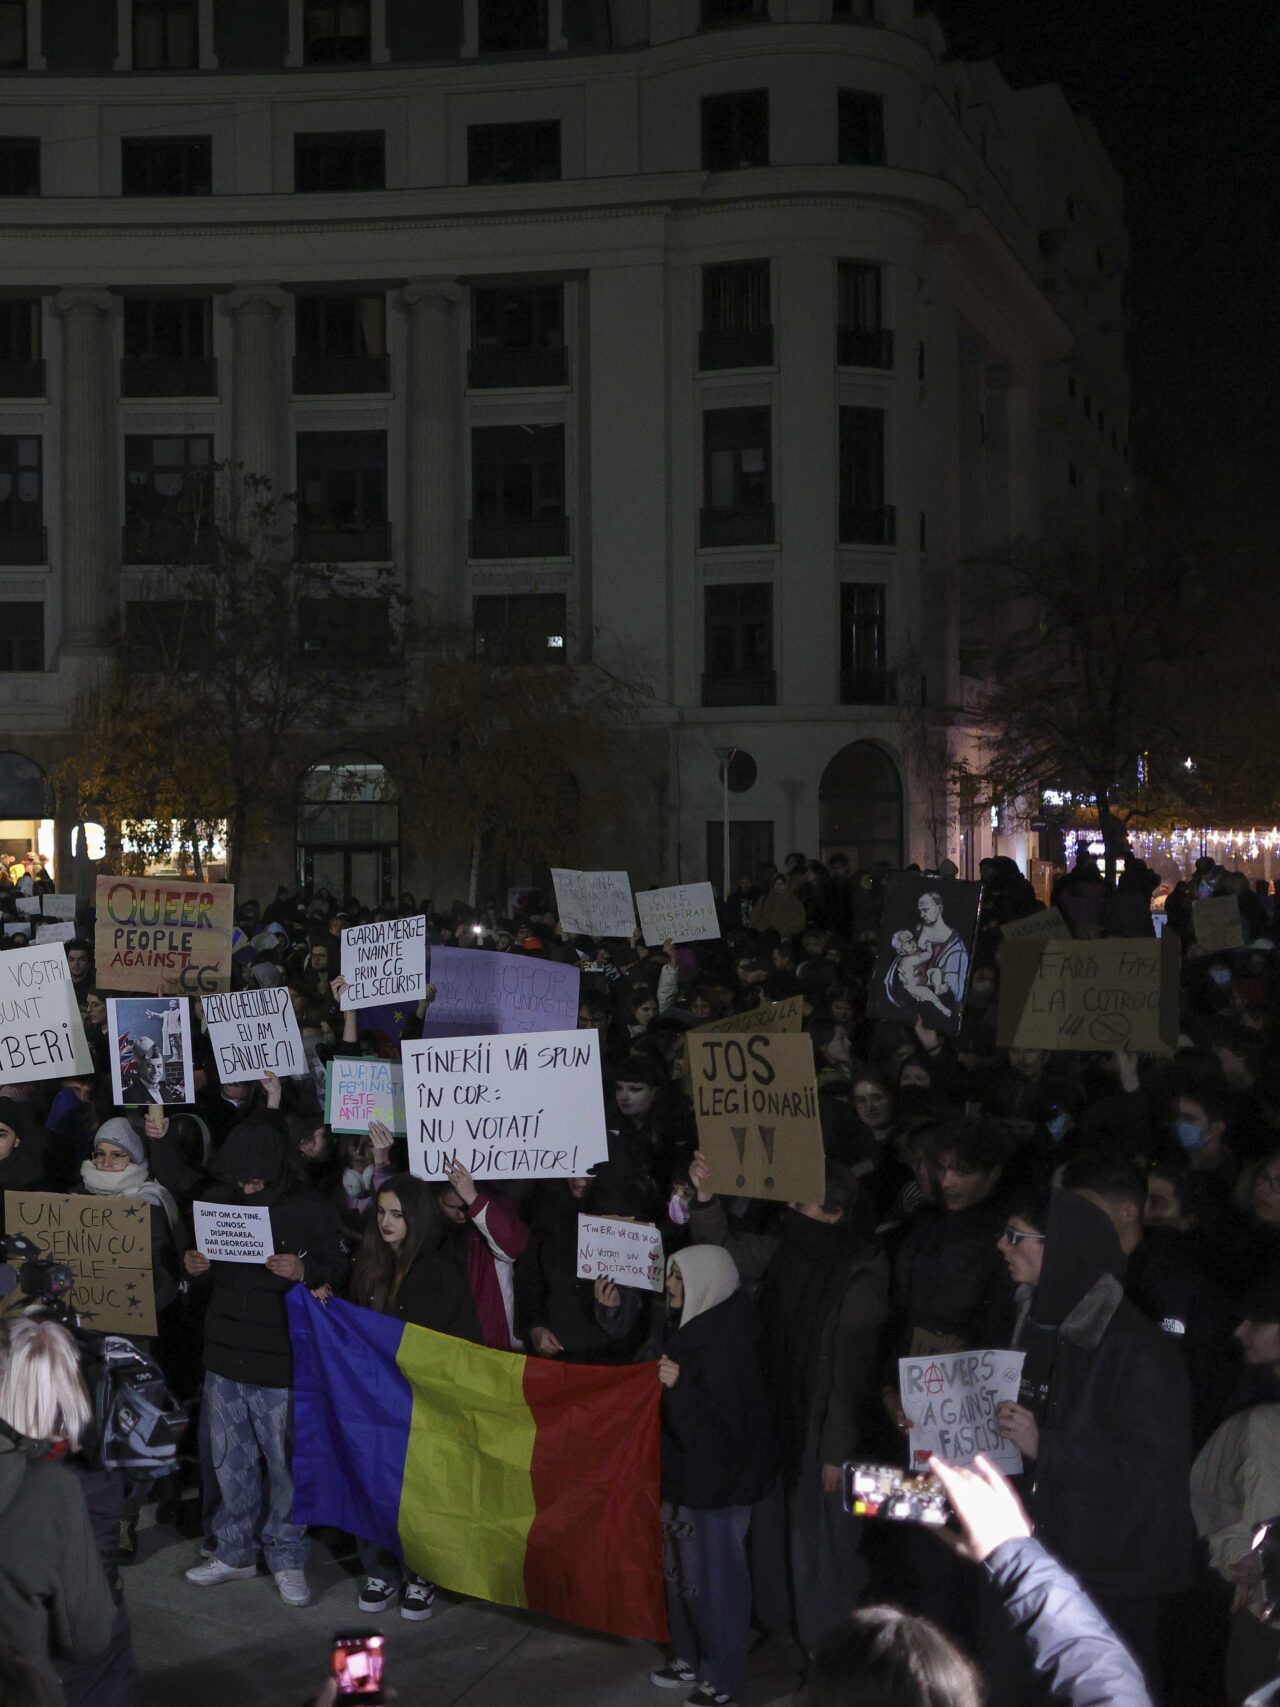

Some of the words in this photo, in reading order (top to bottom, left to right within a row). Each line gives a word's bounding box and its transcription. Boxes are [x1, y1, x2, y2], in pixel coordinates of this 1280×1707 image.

[108, 883, 214, 928] QUEER
[114, 928, 192, 951] PEOPLE
[347, 924, 385, 946] GARDA
[387, 917, 424, 940] MERGE
[110, 950, 191, 968] AGAINST
[355, 965, 377, 982] PRIN
[383, 958, 403, 976] CG
[180, 960, 219, 992] CG
[348, 983, 369, 1001] CEL
[371, 973, 423, 996] SECURIST
[202, 994, 231, 1024] ZERO
[1032, 988, 1066, 1012] LA
[237, 1024, 252, 1041] EU
[258, 1023, 274, 1040] AM
[538, 1045, 590, 1068] SPUN
[703, 1035, 775, 1085] JOS
[340, 1063, 390, 1080] LUPTA
[339, 1080, 400, 1095] FEMINIST
[343, 1093, 375, 1105] ESTE
[417, 1083, 443, 1108] ÎN
[699, 1084, 816, 1118] LEGIONARII
[420, 1118, 454, 1143] NU
[424, 1148, 456, 1175] UN
[471, 1145, 578, 1174] DICTATOR!
[18, 1202, 61, 1228] UN
[80, 1206, 119, 1232] CER
[201, 1209, 218, 1218] SUNT
[219, 1211, 231, 1219] OM
[232, 1212, 242, 1220] CA
[243, 1213, 262, 1221] TINE,
[216, 1220, 247, 1229] CUNOSC
[37, 1228, 102, 1256] SENIN
[108, 1234, 136, 1255] CU
[205, 1238, 220, 1247] DAR
[220, 1239, 264, 1248] GEORGESCU
[210, 1229, 255, 1239] DISPERAREA,
[207, 1248, 218, 1256] NU
[224, 1249, 264, 1257] SALVAREA!
[580, 1243, 594, 1260] NU
[626, 1252, 639, 1260] UN
[905, 1351, 996, 1397] RAVERS
[923, 1386, 999, 1426] AGAINST
